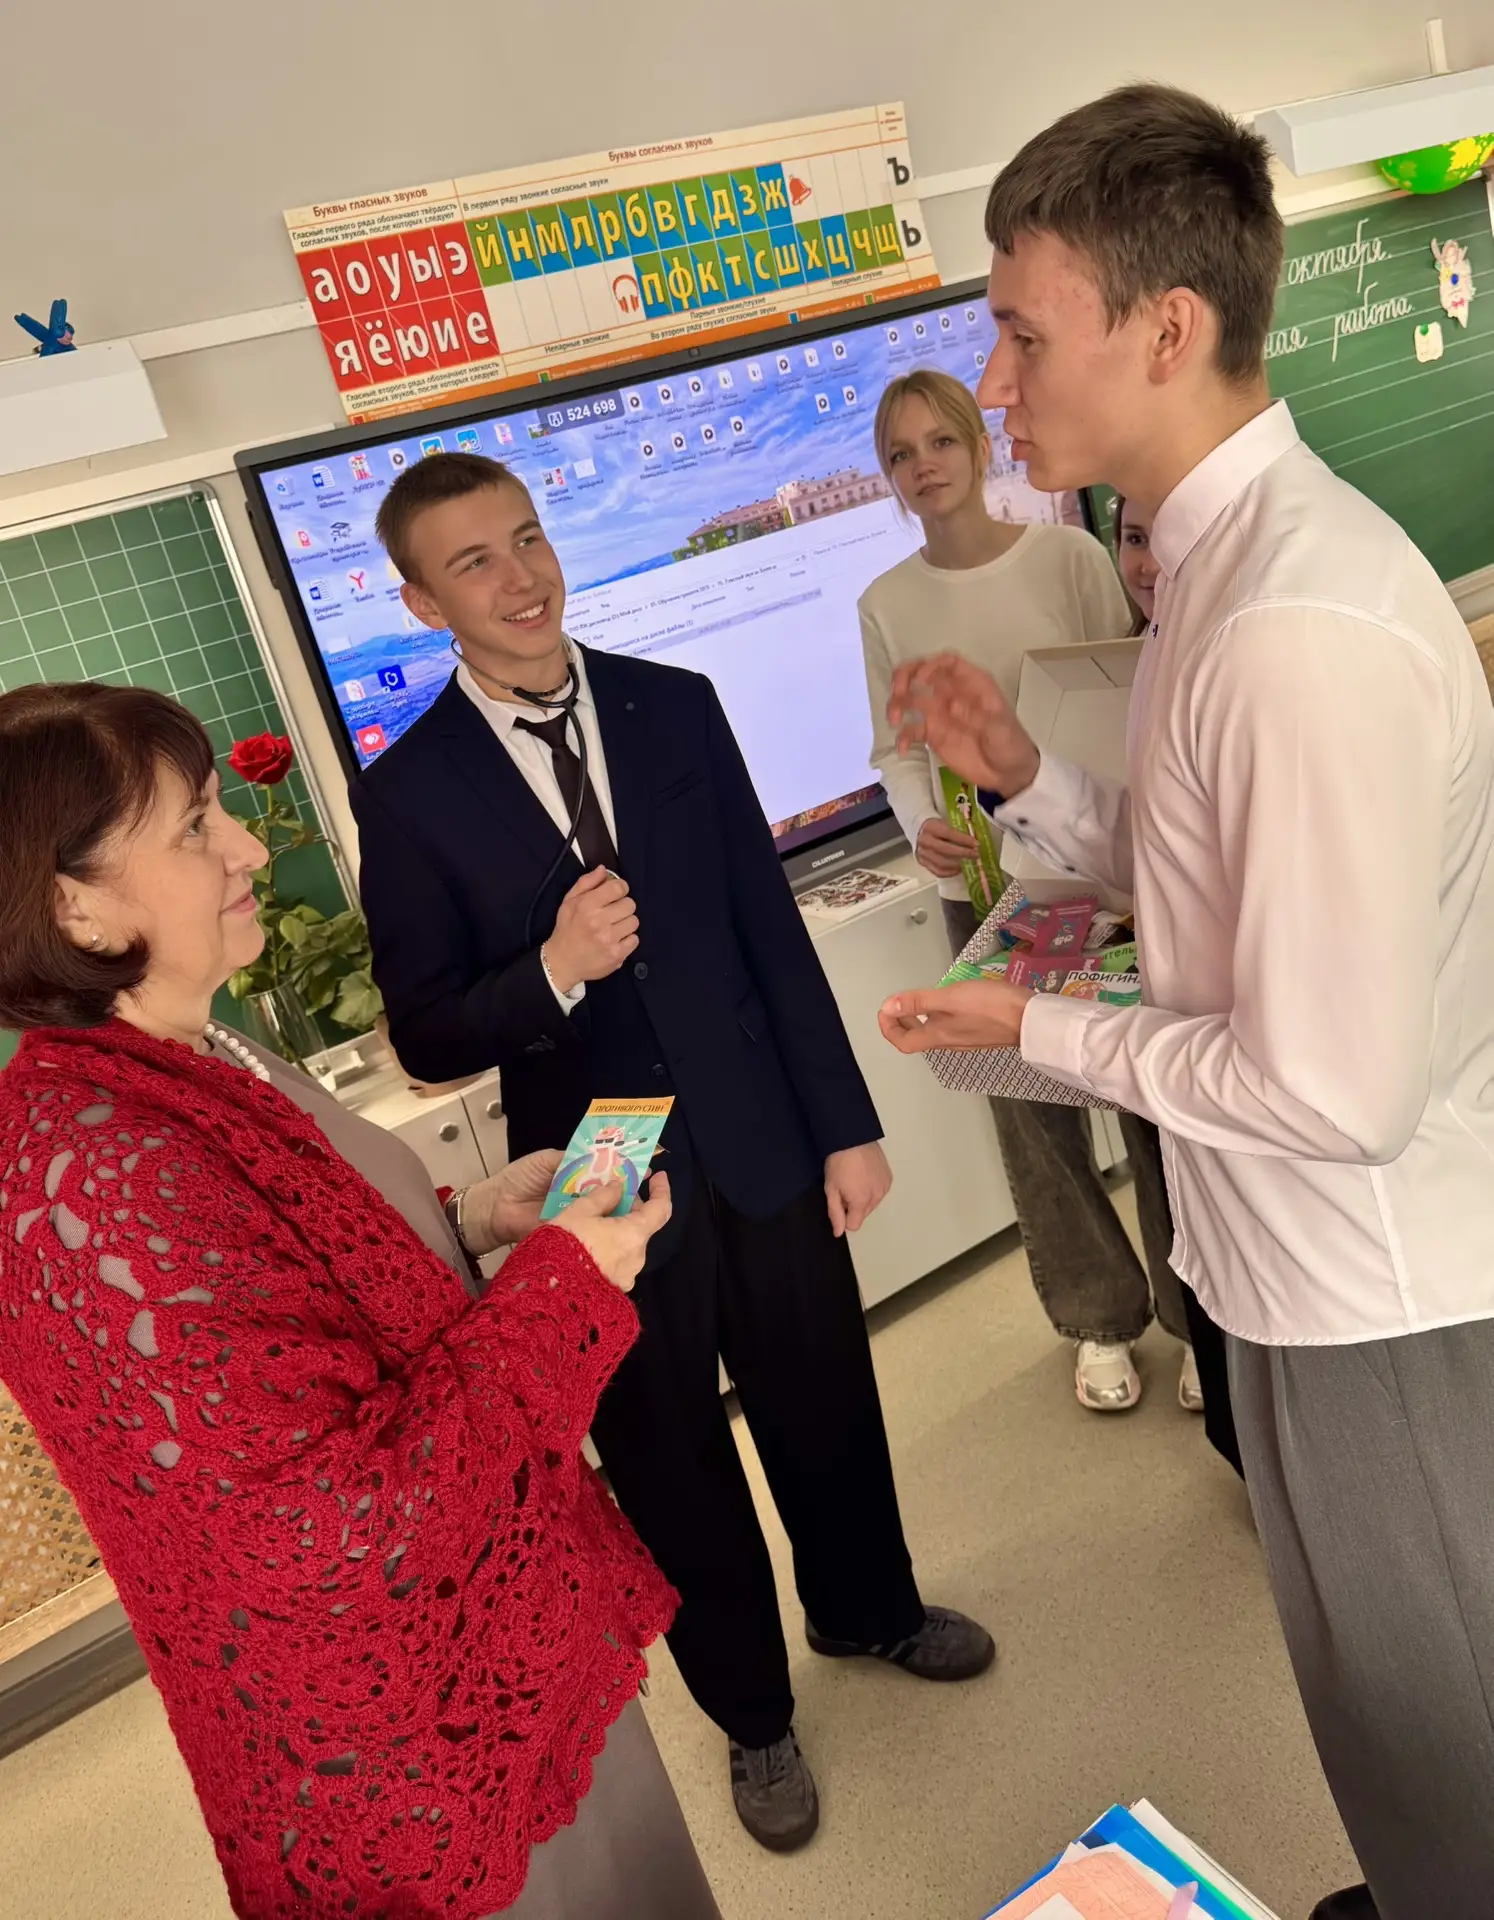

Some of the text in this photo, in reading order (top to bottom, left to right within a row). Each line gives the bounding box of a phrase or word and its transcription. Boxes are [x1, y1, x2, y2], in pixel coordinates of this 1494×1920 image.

[608, 137, 713, 162] Буквы согласных звуков
[312, 188, 428, 218] Буквы гласных звуков
[463, 178, 609, 211] В первом ряду звонкие согласные звуки
[292, 203, 458, 240] Гласные первого ряда обозначают твёрдость
[300, 212, 454, 248] согласных звуков, после которых следуют
[831, 274, 862, 287] Непарные
[650, 332, 660, 340] Во
[660, 328, 686, 340] втором
[686, 323, 702, 334] ряду
[726, 310, 758, 323] согласные
[759, 306, 777, 317] звуки
[690, 308, 716, 320] Парные
[544, 332, 610, 354] Непарные звонкие
[346, 361, 500, 402] Гласные второго ряда обозначают мягкость
[352, 396, 390, 410] согласных
[418, 384, 439, 396] после
[439, 377, 470, 392] которых
[470, 370, 500, 384] следуют
[566, 398, 617, 422] 524 698
[1068, 972, 1141, 984] ПОФИГИН
